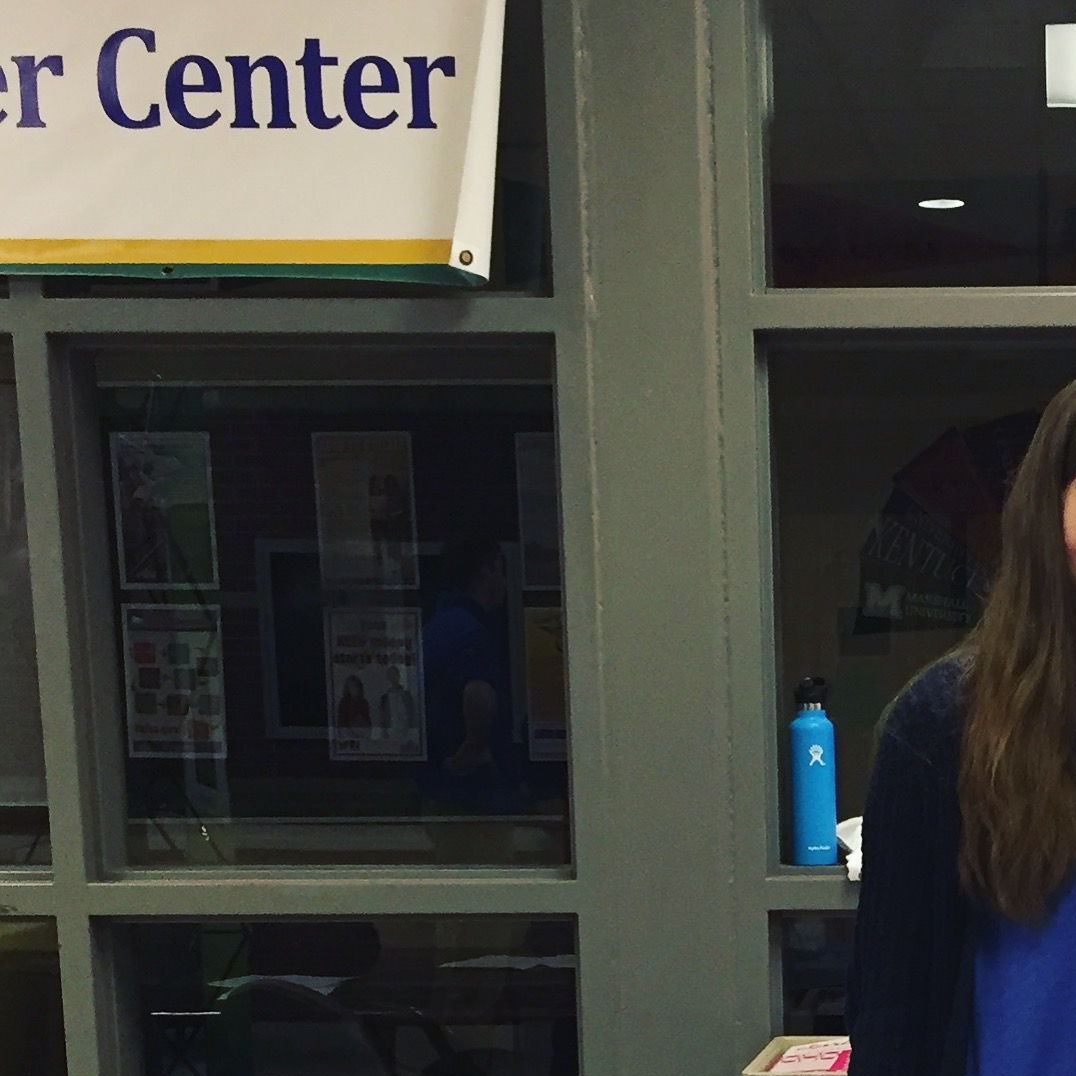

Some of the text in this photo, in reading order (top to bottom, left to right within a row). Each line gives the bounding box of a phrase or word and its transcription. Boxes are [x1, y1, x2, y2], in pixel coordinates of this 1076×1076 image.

[0, 28, 456, 130] r Center
[867, 517, 988, 603] KENTUCK
